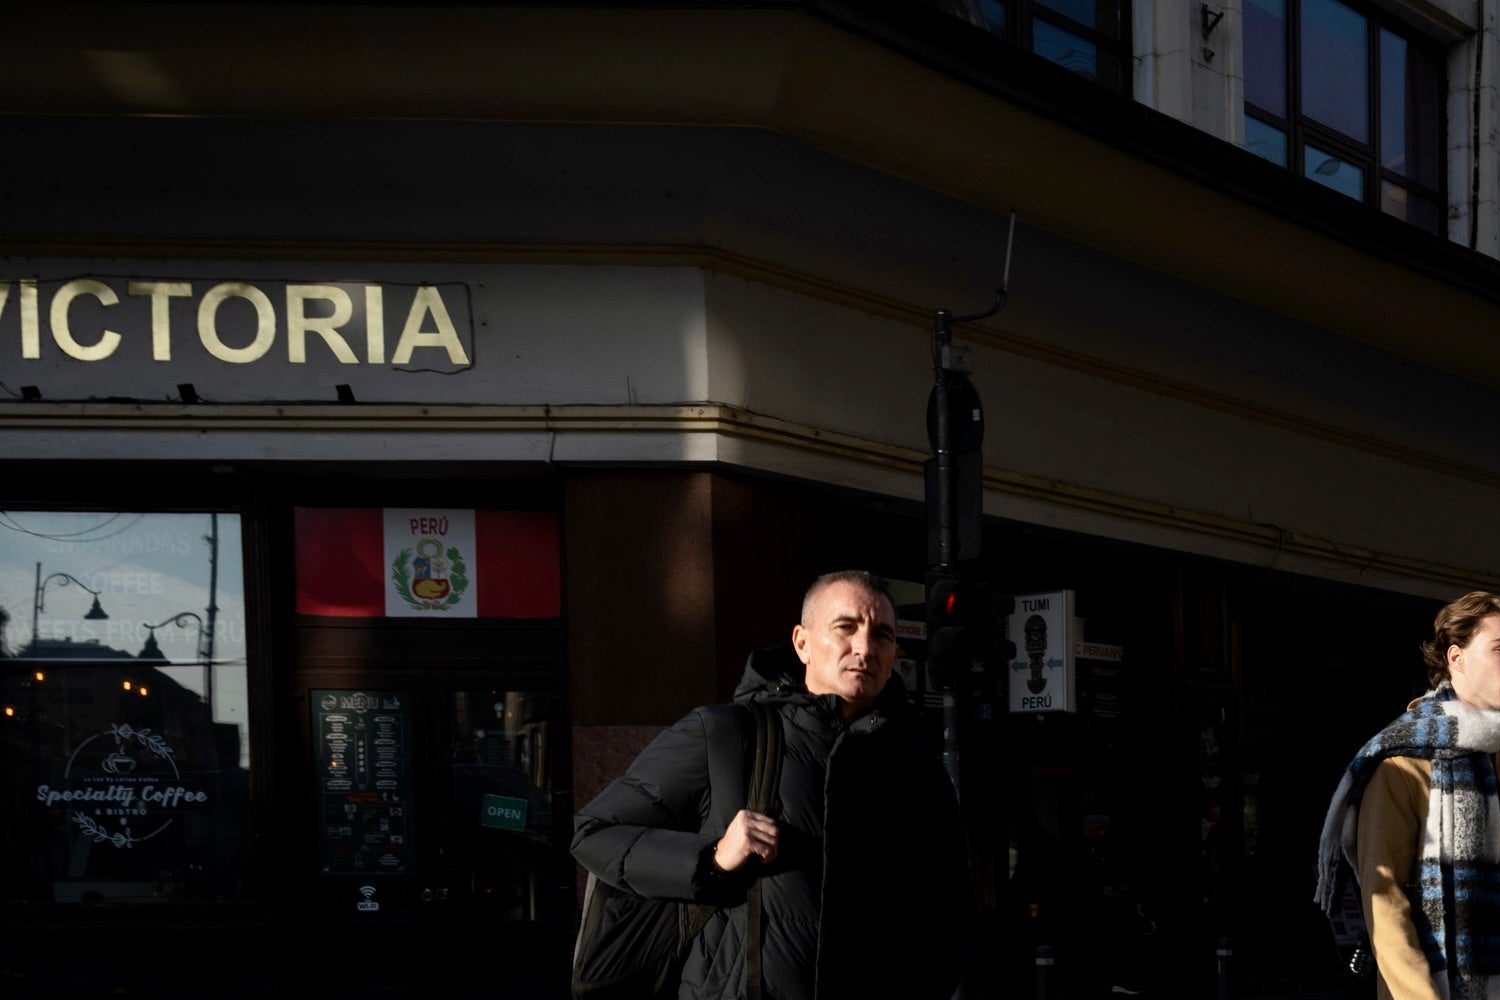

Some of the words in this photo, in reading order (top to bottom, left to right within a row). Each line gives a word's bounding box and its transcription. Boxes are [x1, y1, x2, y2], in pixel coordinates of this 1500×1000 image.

[0, 279, 471, 366] ICTORIA
[409, 516, 450, 537] PERÚ
[1022, 598, 1050, 612] TUMI
[340, 695, 379, 709] MENU
[1022, 693, 1052, 709] PERÚ
[36, 784, 137, 808] Specialty
[140, 784, 208, 808] Coffee
[488, 805, 521, 821] OPEN
